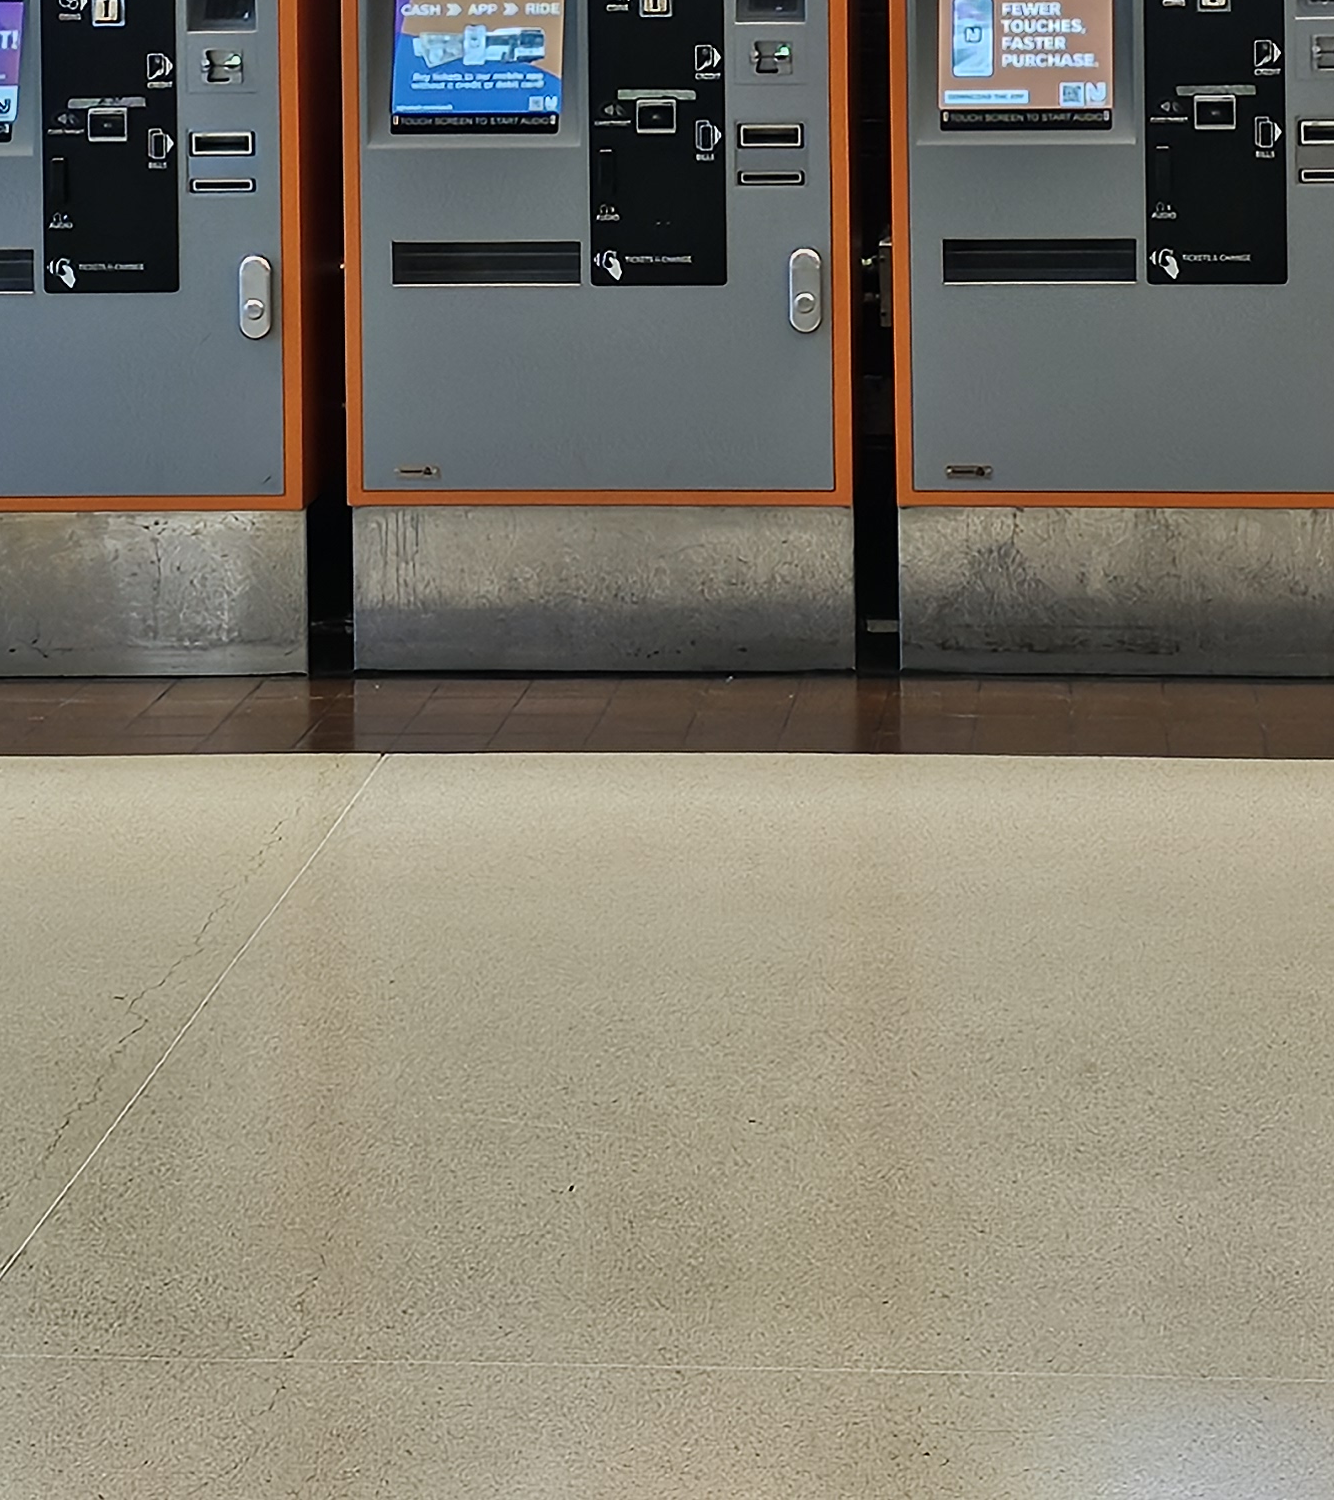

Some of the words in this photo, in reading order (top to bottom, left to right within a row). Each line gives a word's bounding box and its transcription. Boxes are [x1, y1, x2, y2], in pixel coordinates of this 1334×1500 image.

[401, 3, 441, 16] CASH
[468, 3, 498, 16] APP
[525, 3, 560, 15] RIDE
[1001, 2, 1061, 16] FEWER
[1001, 19, 1086, 34] TOUCHES,
[1001, 36, 1066, 51] FASTER
[1001, 53, 1099, 68] PURCHASE.
